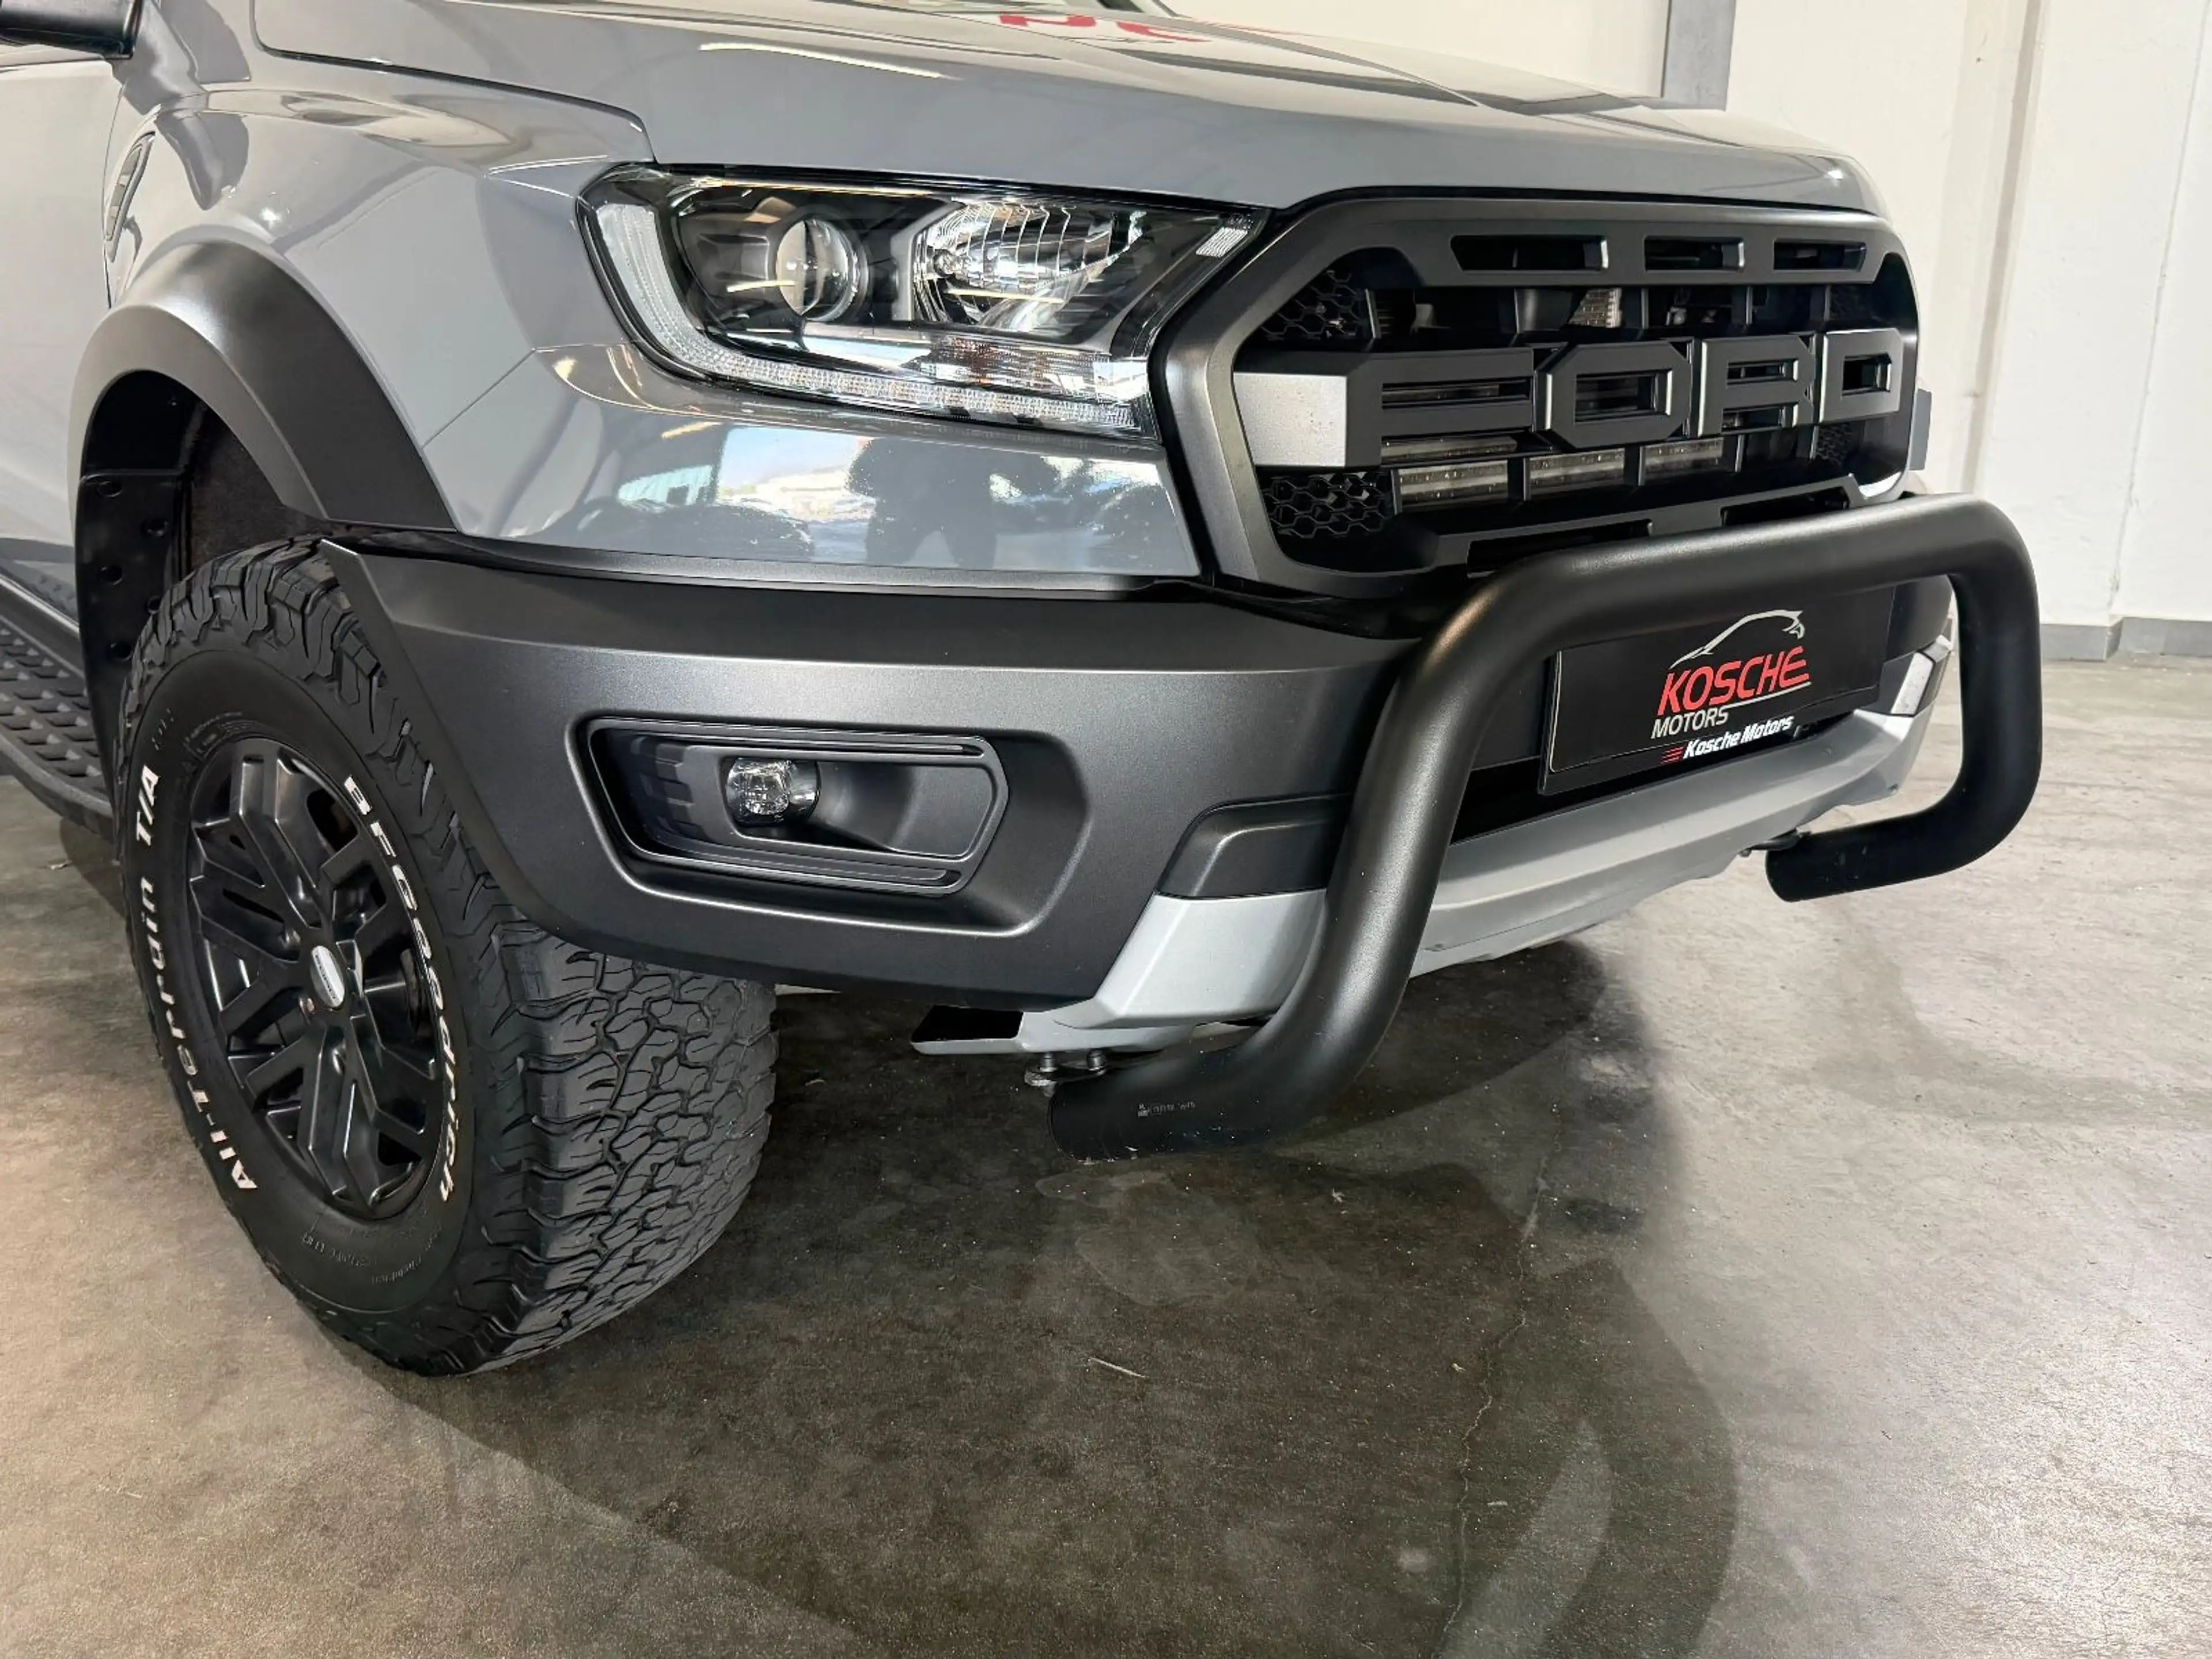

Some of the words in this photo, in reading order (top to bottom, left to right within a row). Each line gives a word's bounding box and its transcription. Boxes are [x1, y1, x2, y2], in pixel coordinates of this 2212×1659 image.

[1346, 328, 1901, 465] FORD
[1657, 646, 1809, 715] KOSCHE
[1652, 707, 1728, 739] MOTORS
[1683, 732, 1739, 759] Kosche
[1738, 716, 1794, 744] Motors
[137, 765, 162, 846] T/A
[344, 776, 459, 1202] BFGoodrich
[141, 876, 257, 1189] All-Terrain
